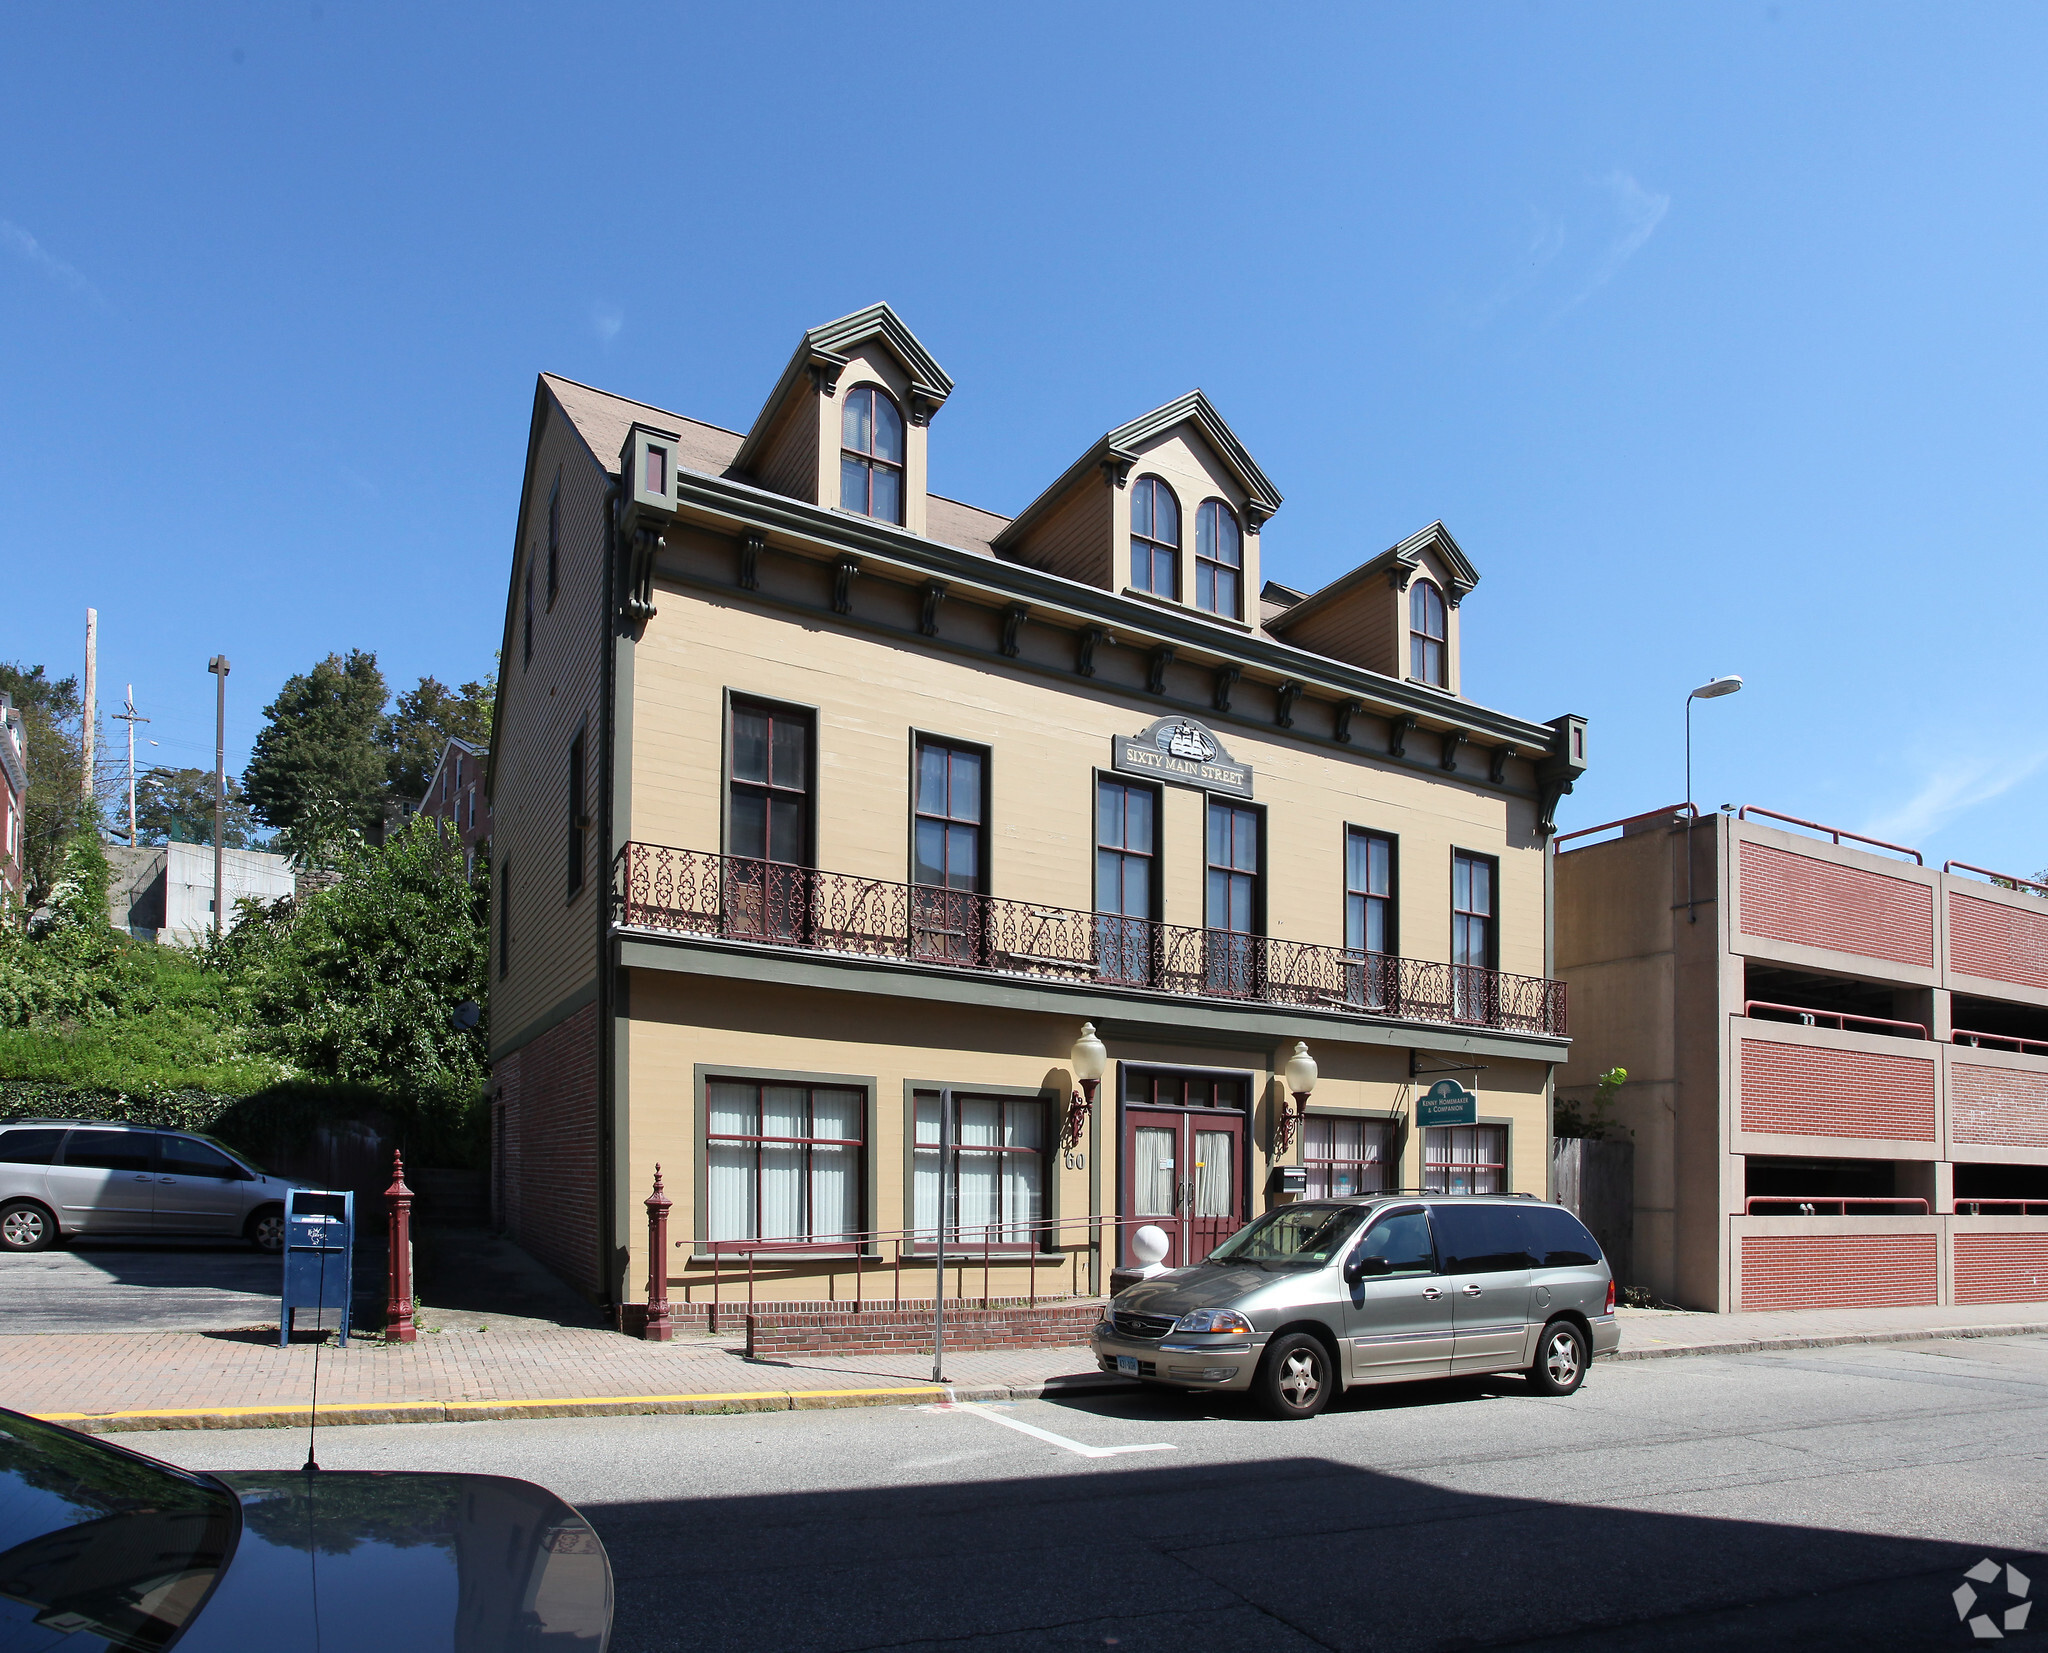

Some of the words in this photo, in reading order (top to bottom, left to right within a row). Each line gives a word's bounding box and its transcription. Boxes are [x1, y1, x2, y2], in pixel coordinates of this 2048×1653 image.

[1126, 748, 1163, 767] SIXTY
[1165, 757, 1198, 776] MAIN
[1201, 765, 1244, 785] STREET
[1439, 1097, 1468, 1105] HOMEMAKER
[1066, 1153, 1085, 1170] 60
